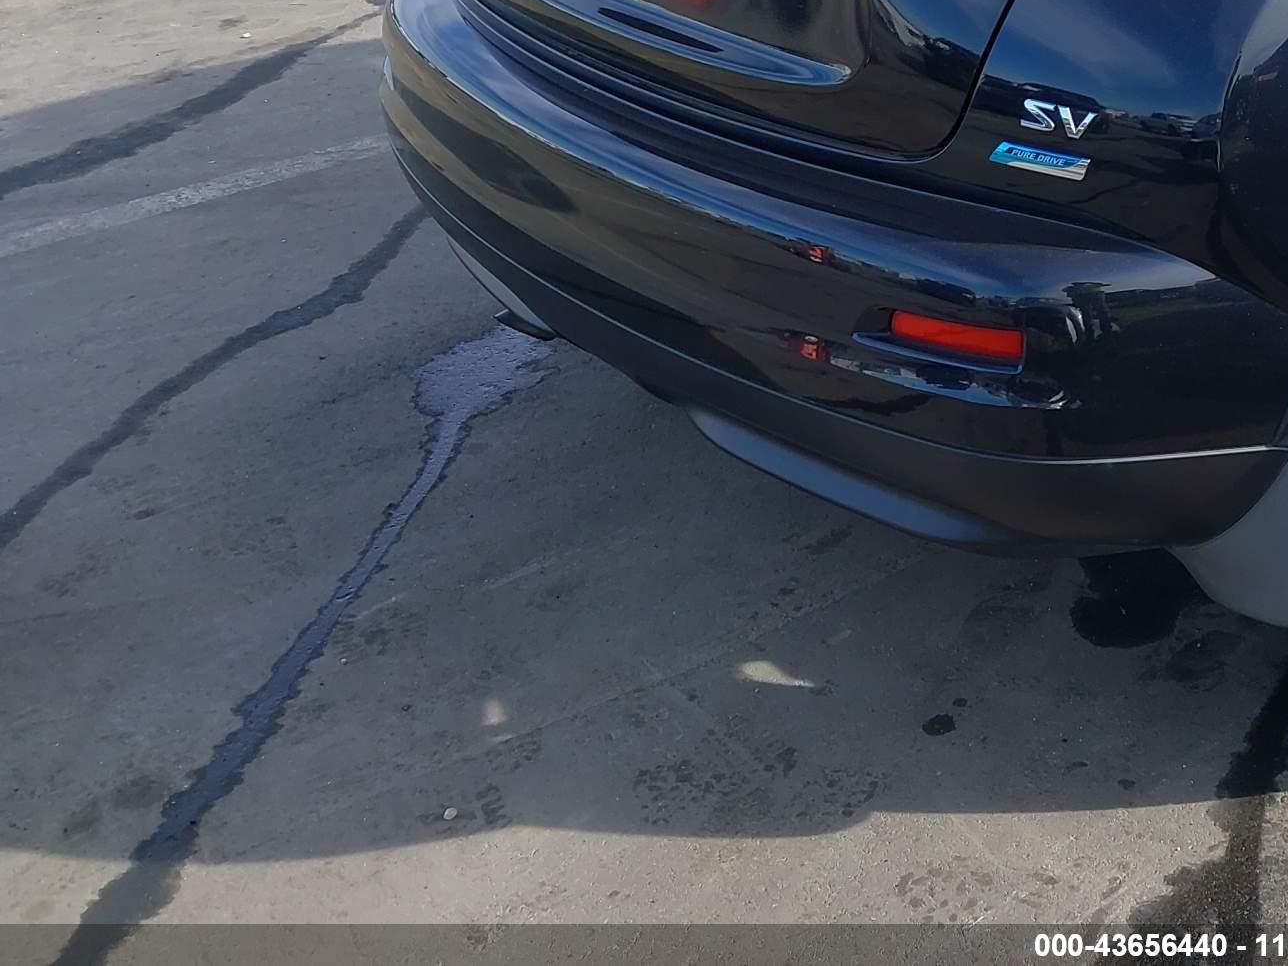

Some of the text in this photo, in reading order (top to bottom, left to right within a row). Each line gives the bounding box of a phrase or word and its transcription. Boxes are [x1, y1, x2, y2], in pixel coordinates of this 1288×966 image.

[1020, 98, 1098, 140] SV
[1012, 149, 1066, 166] PURE DRIVE
